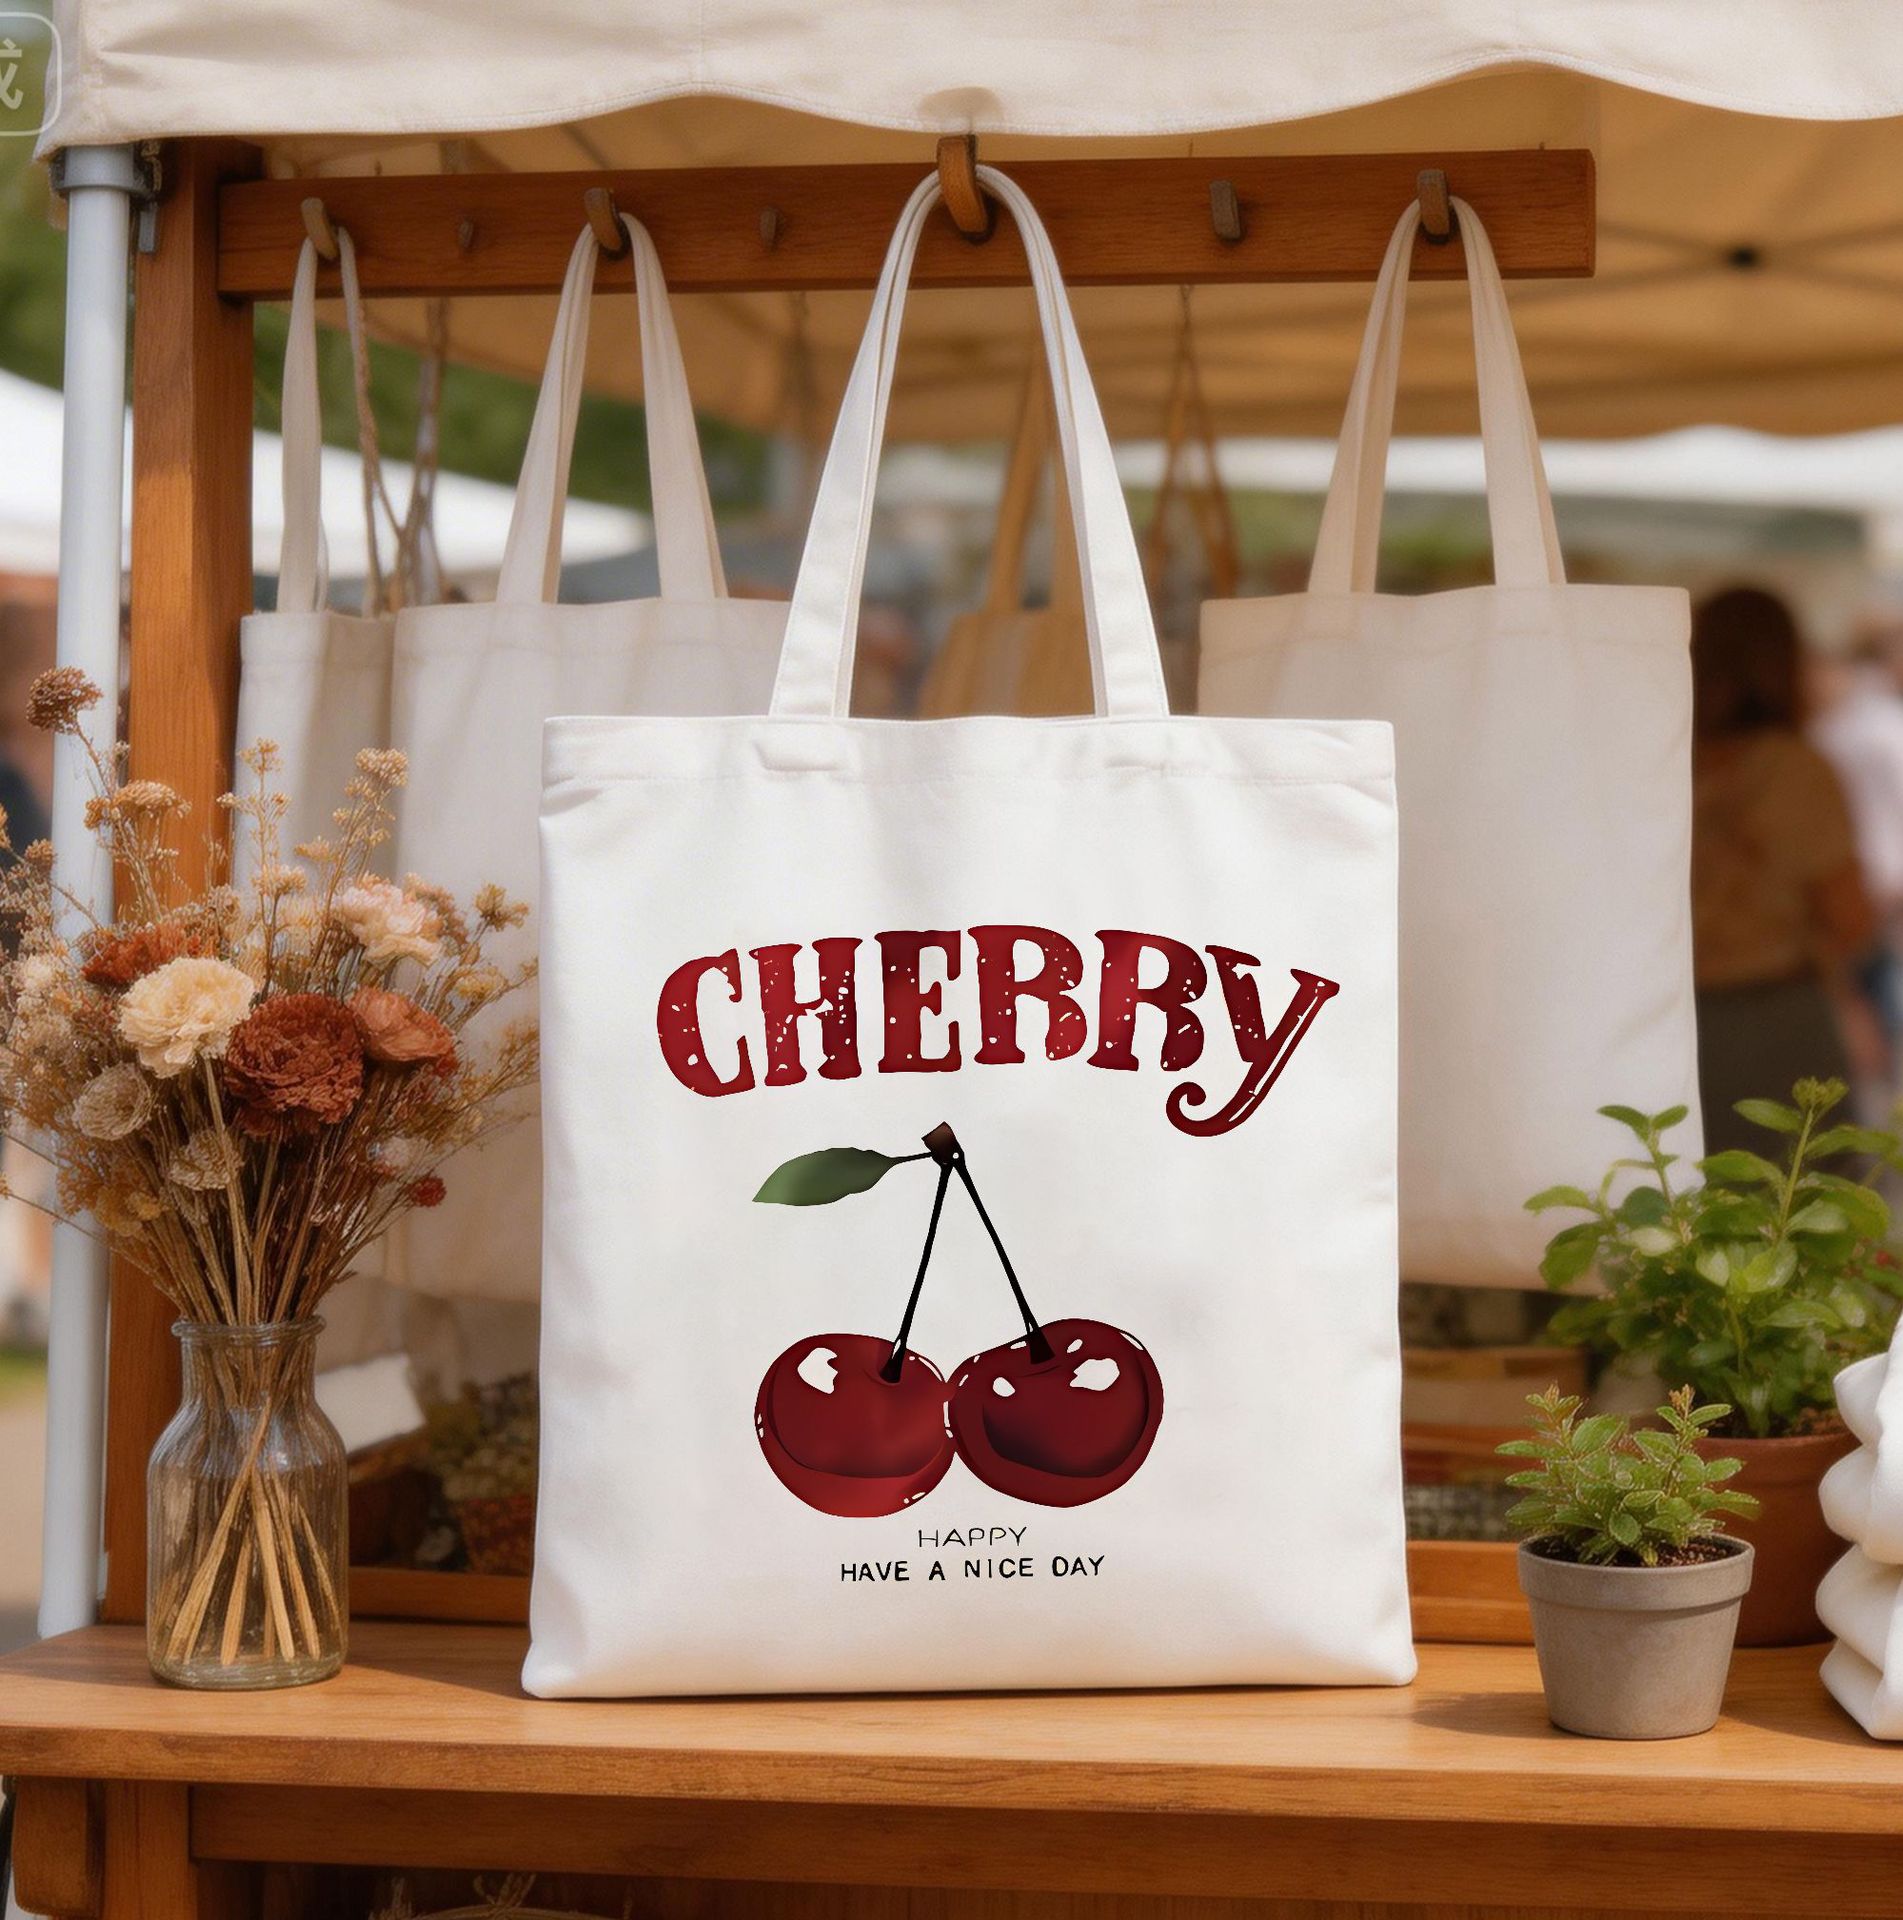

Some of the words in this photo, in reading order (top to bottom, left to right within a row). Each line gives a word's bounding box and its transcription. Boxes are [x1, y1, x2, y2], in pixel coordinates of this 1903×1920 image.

[917, 1526, 1027, 1548] HAPPY
[840, 1560, 910, 1582] HAVE
[928, 1560, 946, 1582] A
[964, 1557, 1034, 1579] NICE
[1051, 1555, 1105, 1577] DAY
